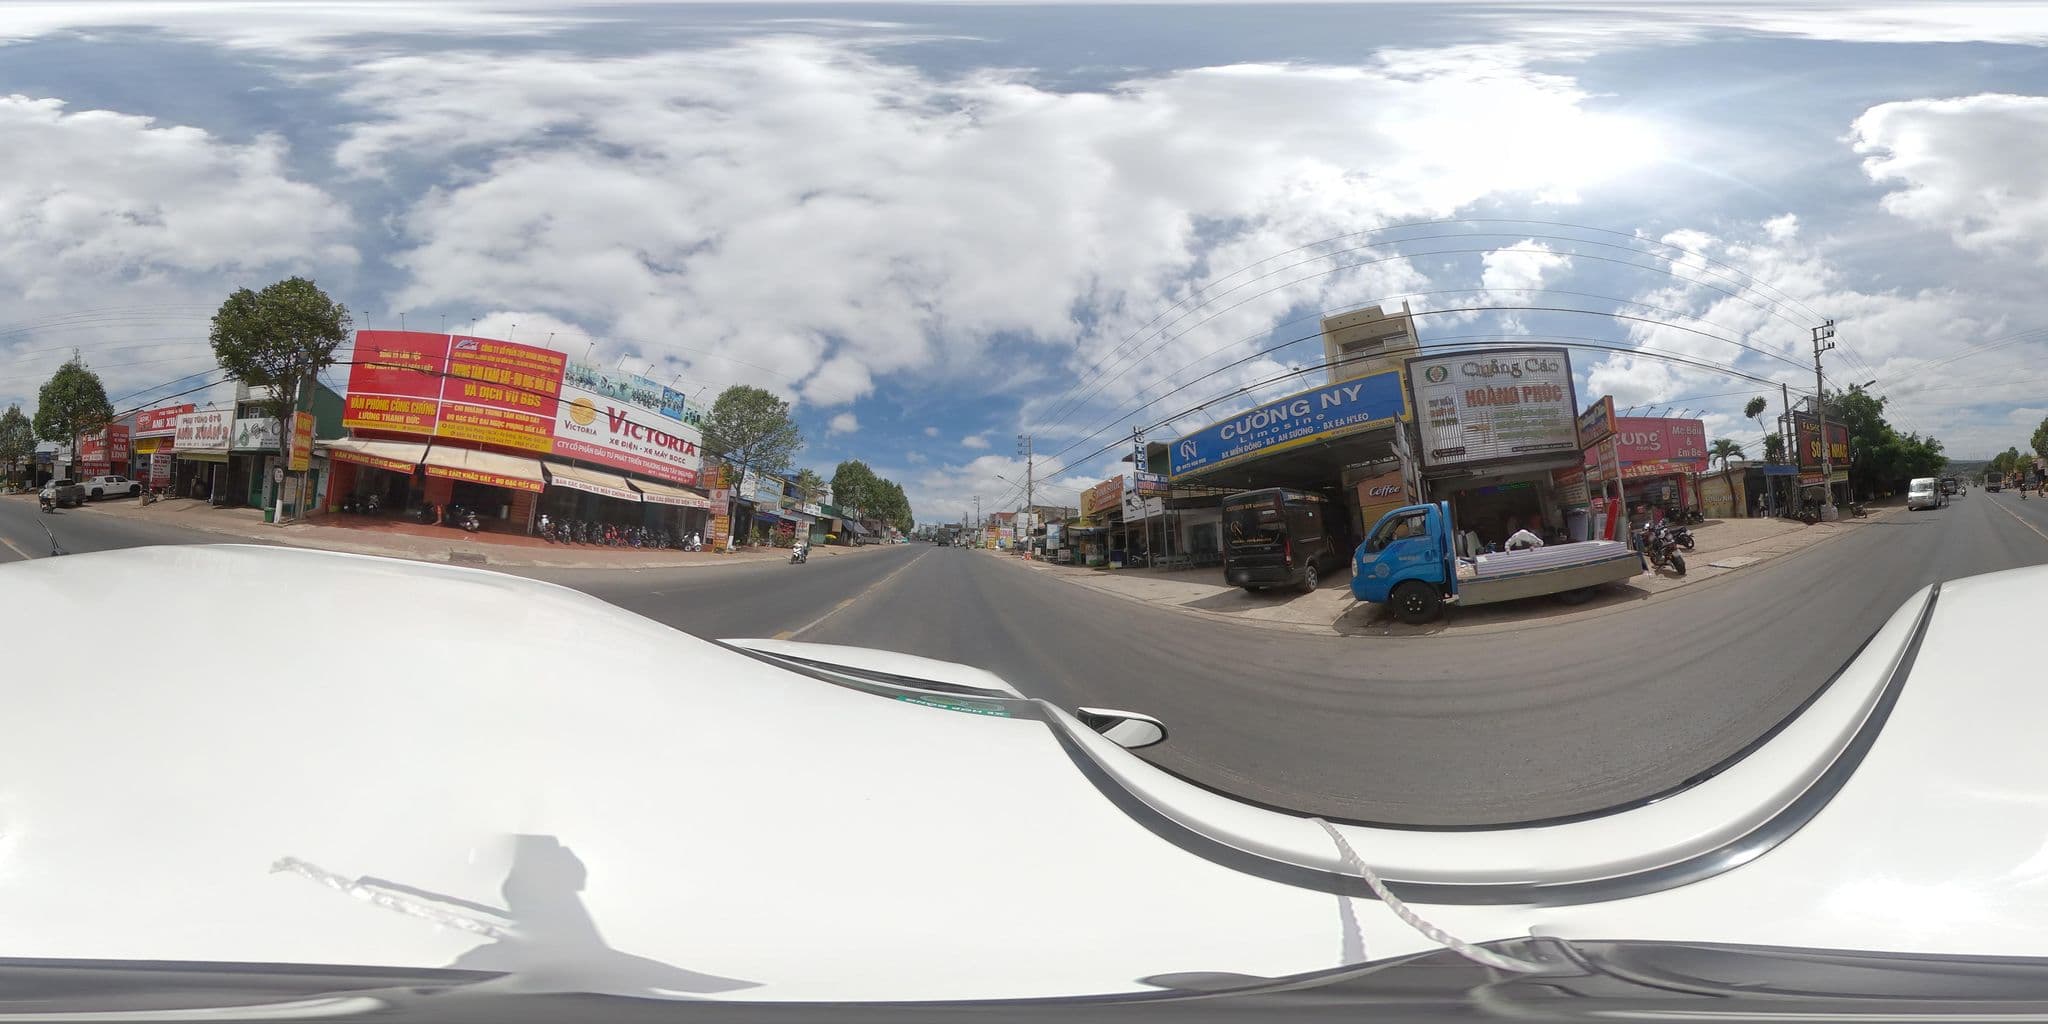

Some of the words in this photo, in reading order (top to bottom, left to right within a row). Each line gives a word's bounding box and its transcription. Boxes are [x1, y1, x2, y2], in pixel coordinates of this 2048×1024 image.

[1462, 358, 1522, 379] Quảng
[1525, 358, 1560, 373] Cáo
[464, 381, 477, 397] VÀ
[505, 389, 519, 406] VỤ
[1465, 385, 1520, 408] HOÀNG
[1522, 382, 1563, 403] PHÚC
[351, 396, 366, 409] VĂN
[366, 396, 389, 411] PHÒNG
[390, 399, 410, 413] CÔNG
[411, 401, 437, 416] CHỨNG
[1220, 398, 1311, 440] CƯỜNG
[1320, 383, 1363, 410] NY
[177, 426, 193, 440] ANH
[564, 420, 598, 436] VICTORIA
[606, 405, 696, 457] VICTORIA
[1240, 413, 1325, 444] Limosine
[1244, 441, 1262, 453] ĐÔNG
[1266, 437, 1275, 446] BX
[1278, 433, 1288, 442] AN
[1289, 426, 1314, 439] SƯƠNG
[1323, 421, 1334, 430] BX
[1335, 419, 1346, 428] EA
[557, 440, 569, 449] CTY
[609, 437, 619, 446] XE
[620, 440, 638, 452] ĐIỆN
[643, 447, 653, 456] XE
[653, 450, 668, 460] MÁY
[1677, 447, 1690, 457] Em
[1369, 484, 1401, 497] Coffee
